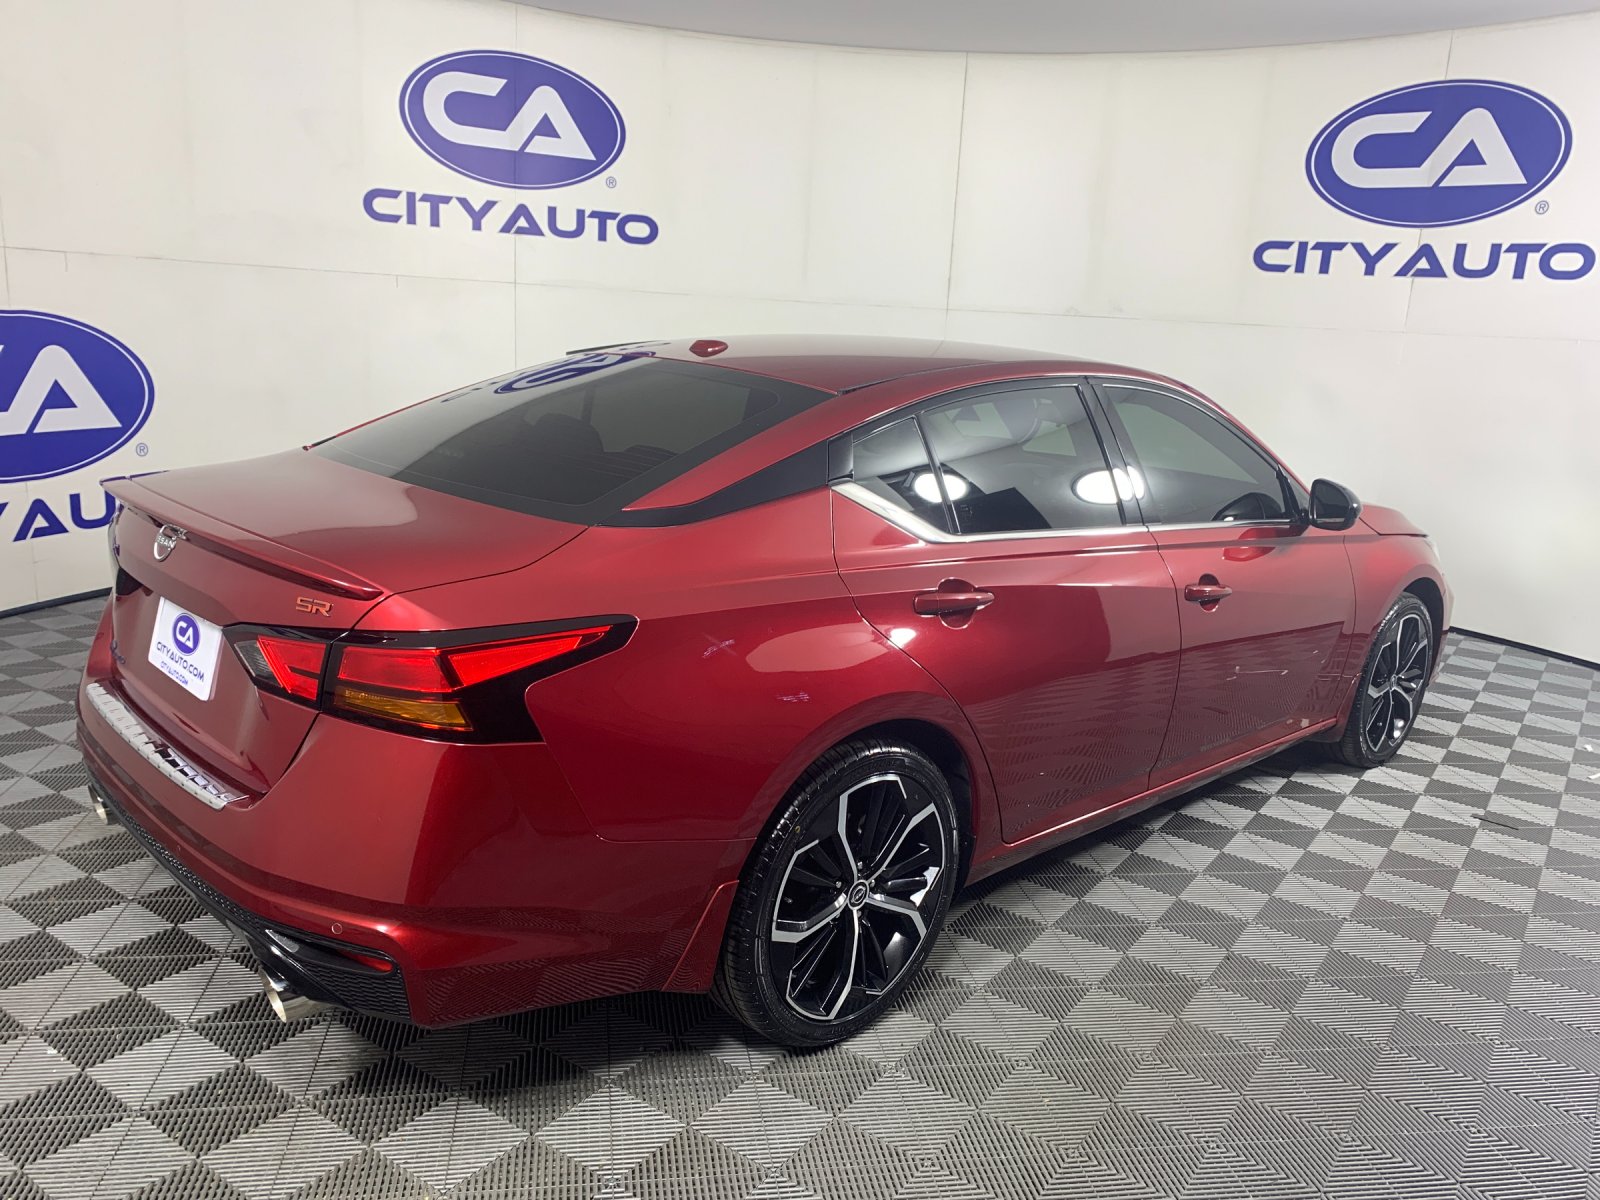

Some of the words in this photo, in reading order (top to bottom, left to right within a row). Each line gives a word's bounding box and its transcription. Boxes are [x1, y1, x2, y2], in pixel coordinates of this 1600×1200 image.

[423, 71, 597, 161] CA
[1331, 107, 1528, 189] CA
[176, 620, 194, 649] CA
[296, 597, 331, 617] SR
